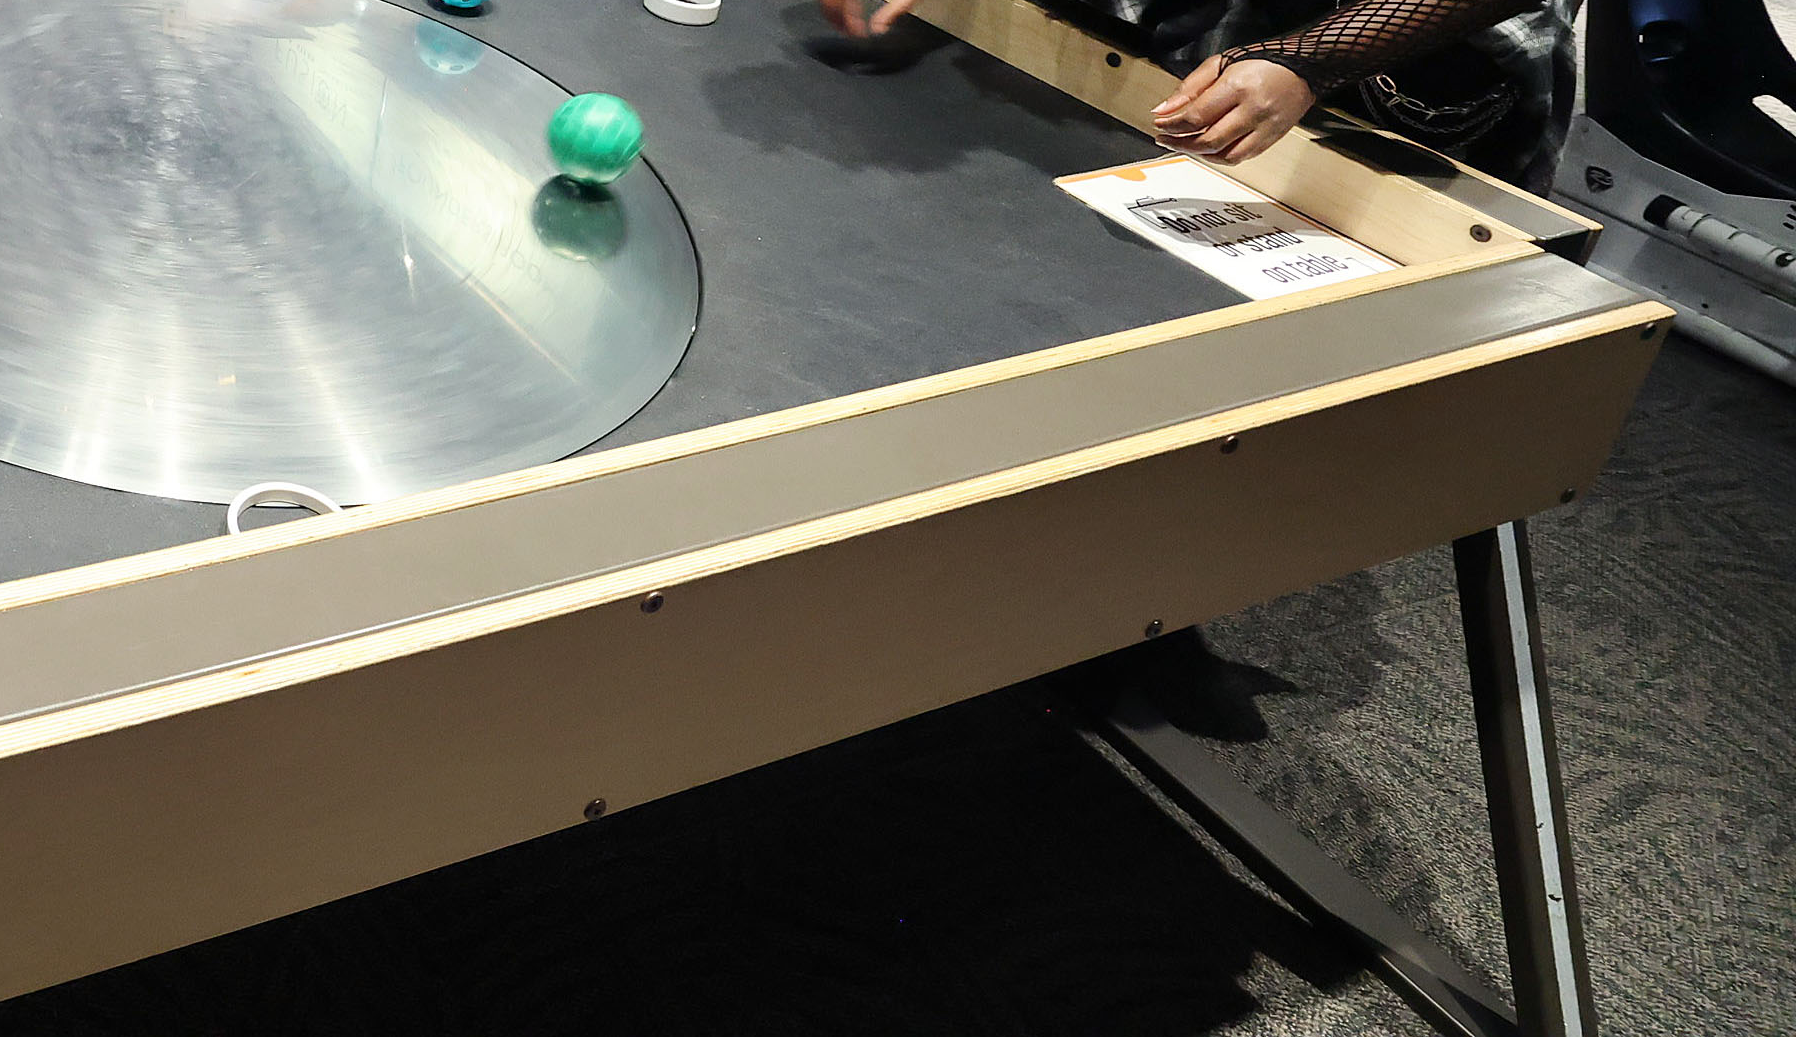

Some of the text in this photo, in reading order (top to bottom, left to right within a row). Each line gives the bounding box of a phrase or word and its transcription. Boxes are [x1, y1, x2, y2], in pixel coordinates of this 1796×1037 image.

[1157, 201, 1264, 234] Do not sit
[1212, 225, 1305, 257] or stand
[1261, 252, 1350, 284] on table
